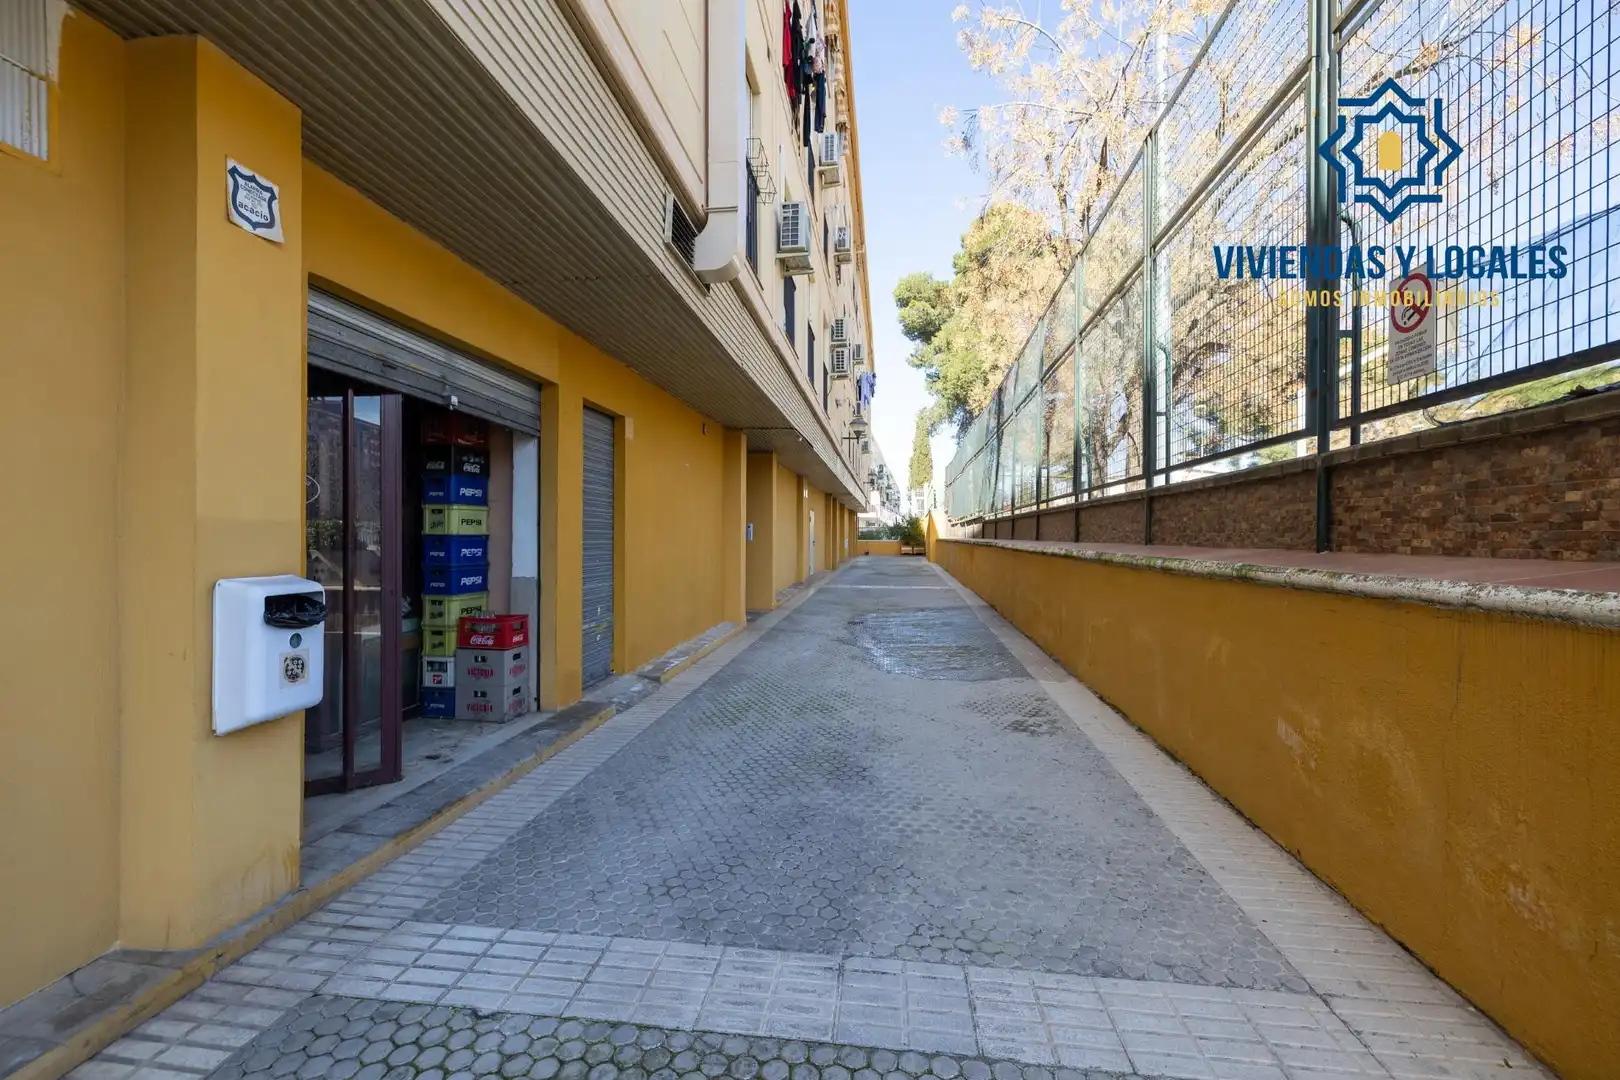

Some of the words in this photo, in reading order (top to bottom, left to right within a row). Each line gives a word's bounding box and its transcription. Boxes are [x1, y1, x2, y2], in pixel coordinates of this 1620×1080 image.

[238, 201, 269, 221] acacio
[460, 487, 482, 497] PEPSI
[460, 518, 482, 526] PEPSI
[460, 548, 482, 557] PEPSI
[460, 576, 483, 586] PEPSI
[467, 667, 494, 677] VICTORIA
